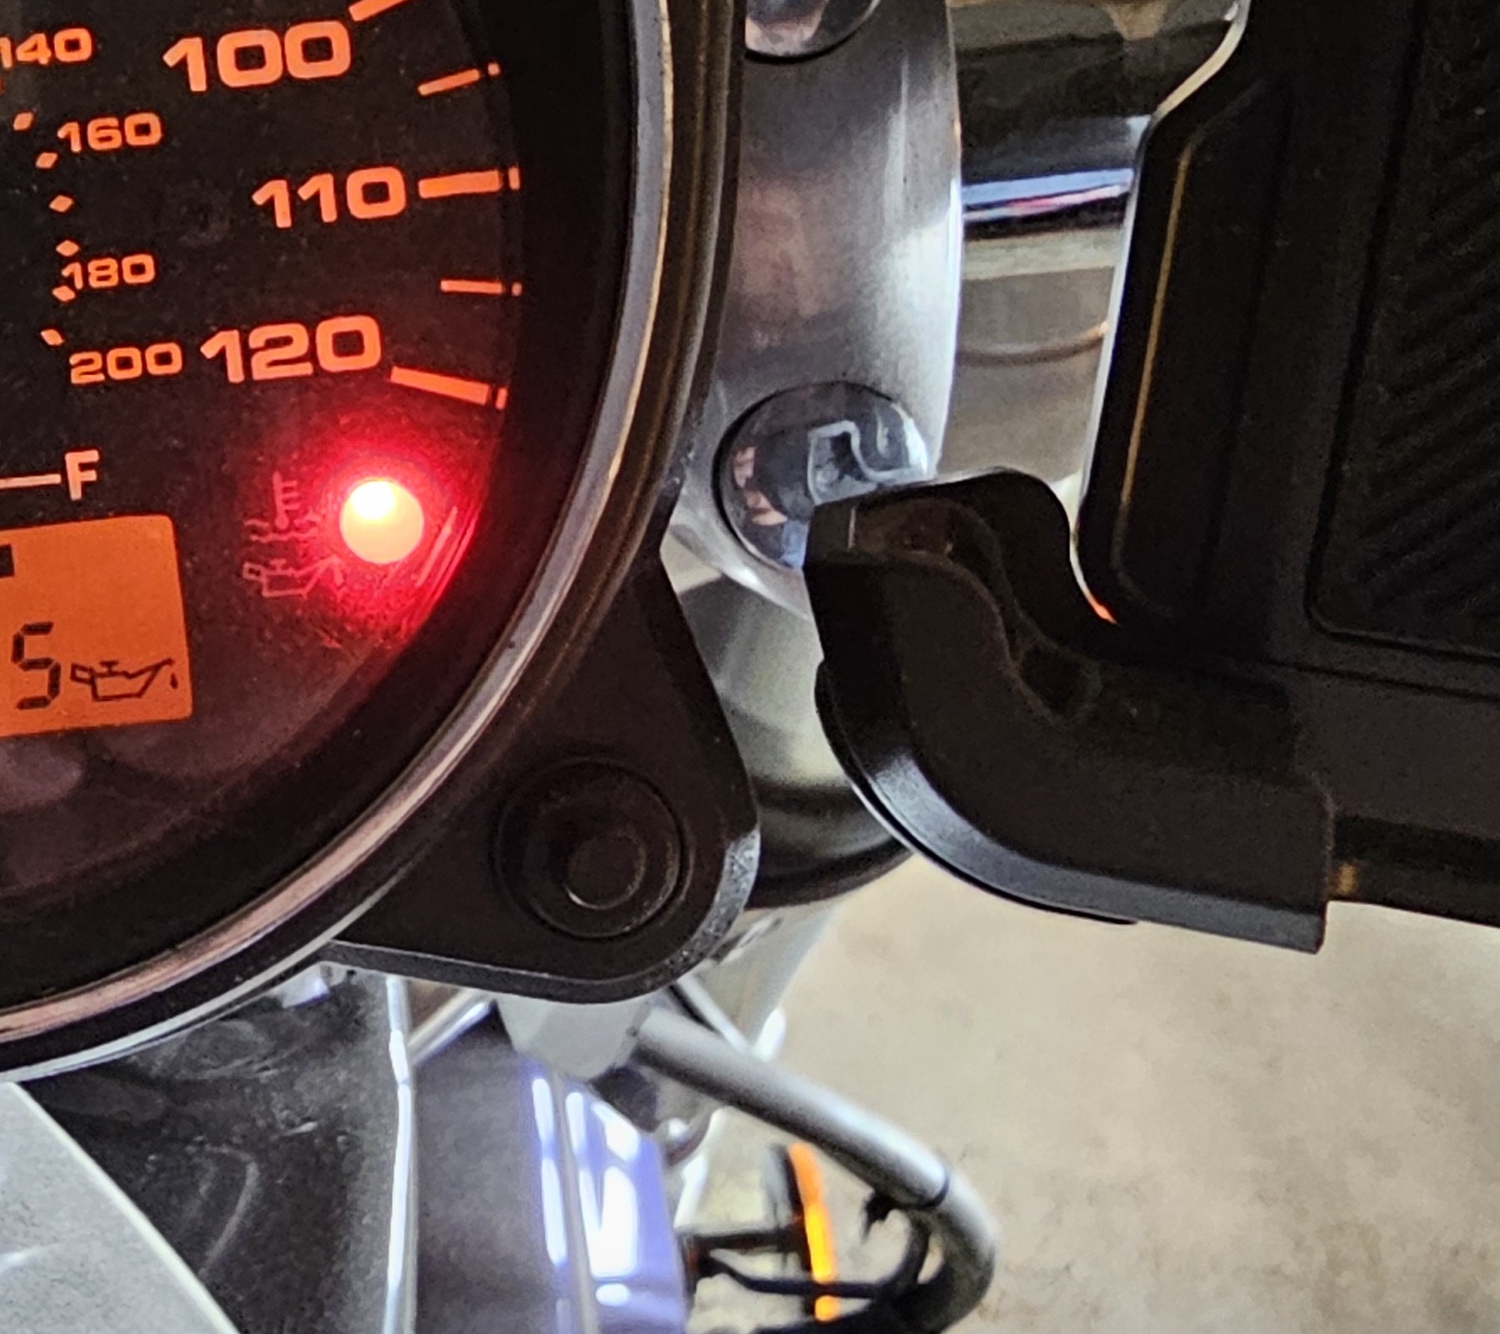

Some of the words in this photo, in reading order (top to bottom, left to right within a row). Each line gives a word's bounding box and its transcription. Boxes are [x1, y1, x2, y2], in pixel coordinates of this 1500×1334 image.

[163, 20, 350, 91] 100
[57, 113, 162, 152] 160
[252, 166, 407, 228] 110
[61, 254, 156, 290] 180
[69, 342, 183, 384] 200
[200, 315, 382, 384] 120
[65, 449, 100, 500] F
